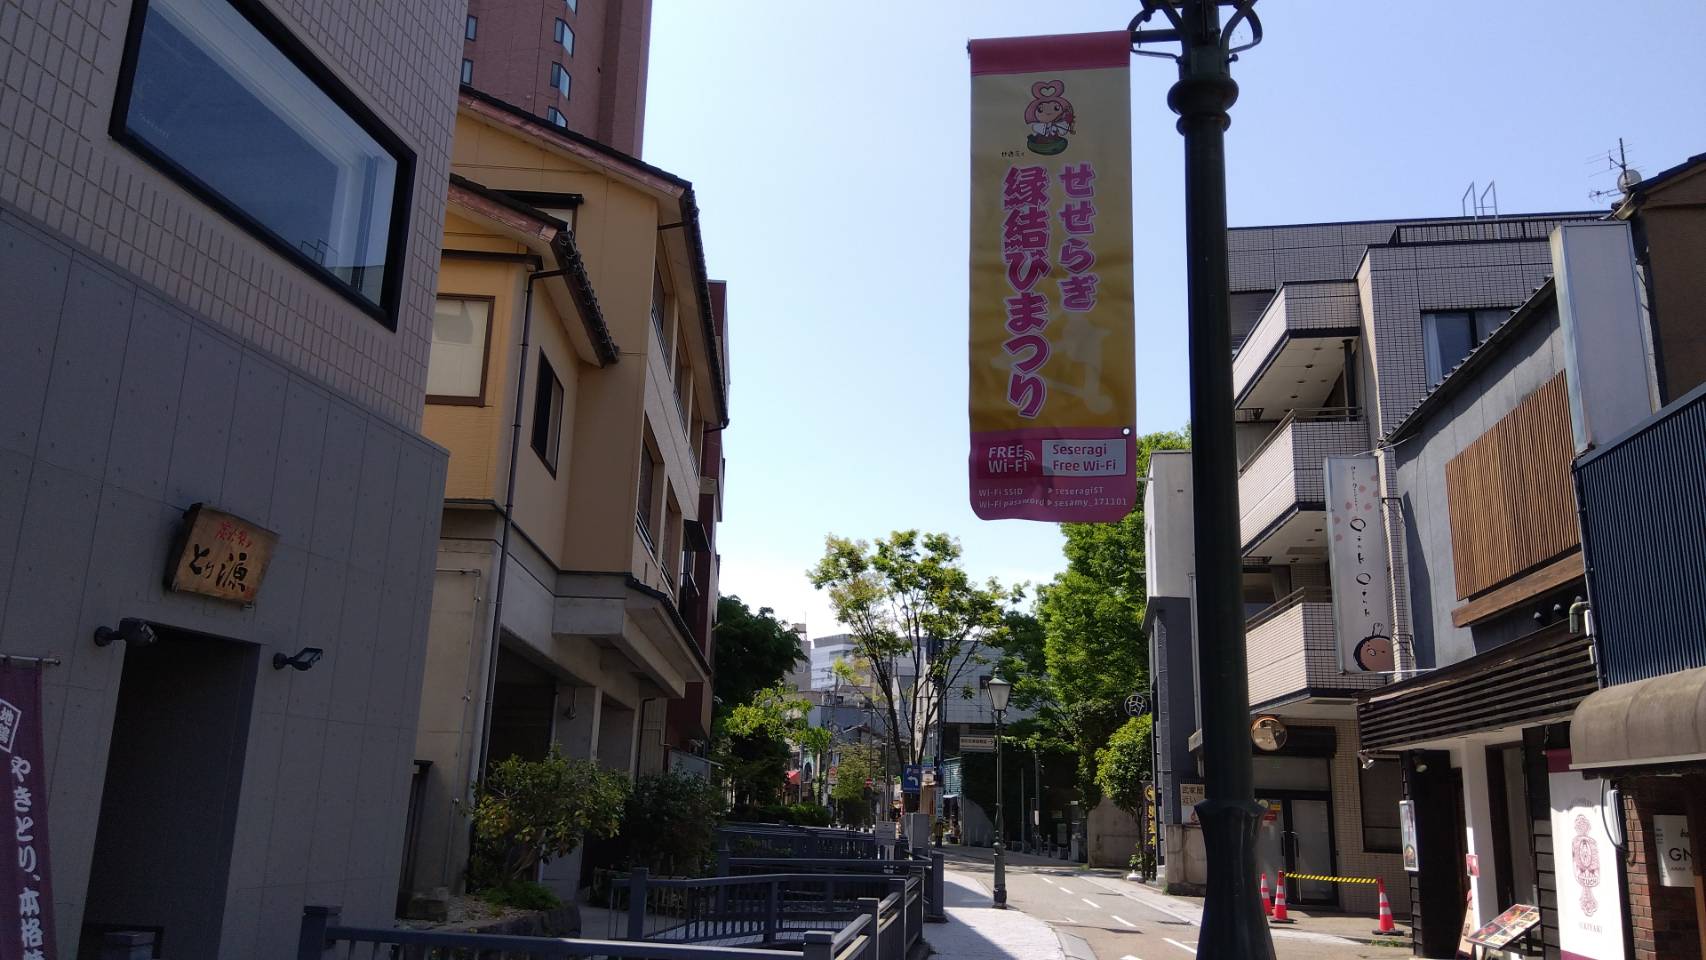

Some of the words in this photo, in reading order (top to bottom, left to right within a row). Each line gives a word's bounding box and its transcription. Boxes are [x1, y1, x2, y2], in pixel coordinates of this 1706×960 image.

[1059, 163, 1099, 312] せせらぎ
[1003, 165, 1051, 418] 縁結びまつり
[988, 444, 1024, 458] FREE
[1052, 443, 1107, 457] Seseragi
[988, 459, 1028, 473] Wi-Fi
[1053, 460, 1080, 472] Free
[1083, 459, 1116, 471] Wi-Fi
